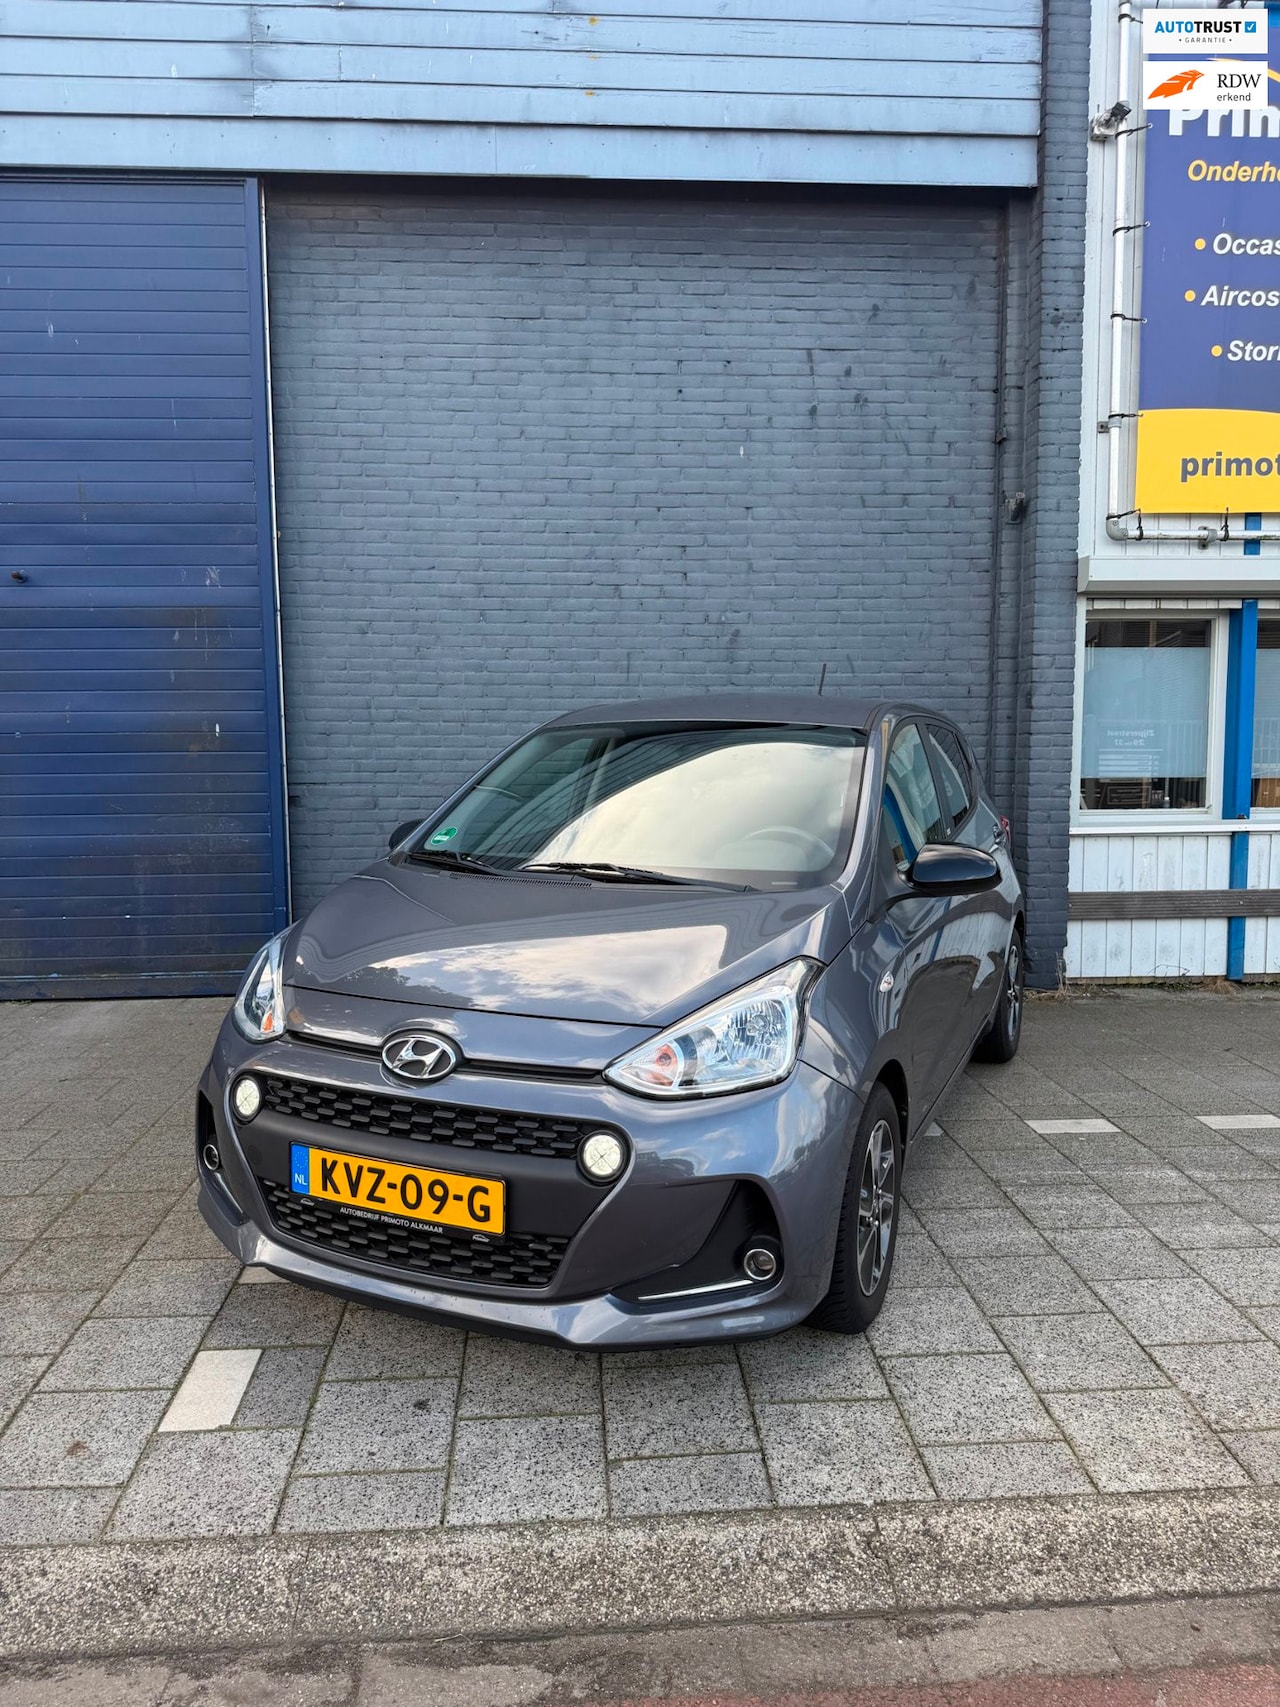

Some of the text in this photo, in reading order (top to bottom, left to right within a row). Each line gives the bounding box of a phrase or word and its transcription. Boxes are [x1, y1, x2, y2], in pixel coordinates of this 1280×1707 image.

[1188, 160, 1280, 182] Onderh
[1200, 285, 1280, 306] Aircos
[1227, 340, 1280, 361] Stor
[294, 1173, 307, 1185] NL
[321, 1157, 491, 1222] KVZ-09-G
[340, 1207, 443, 1234] AUTOBEDRIJF PRIMOTO ALKMAAR
